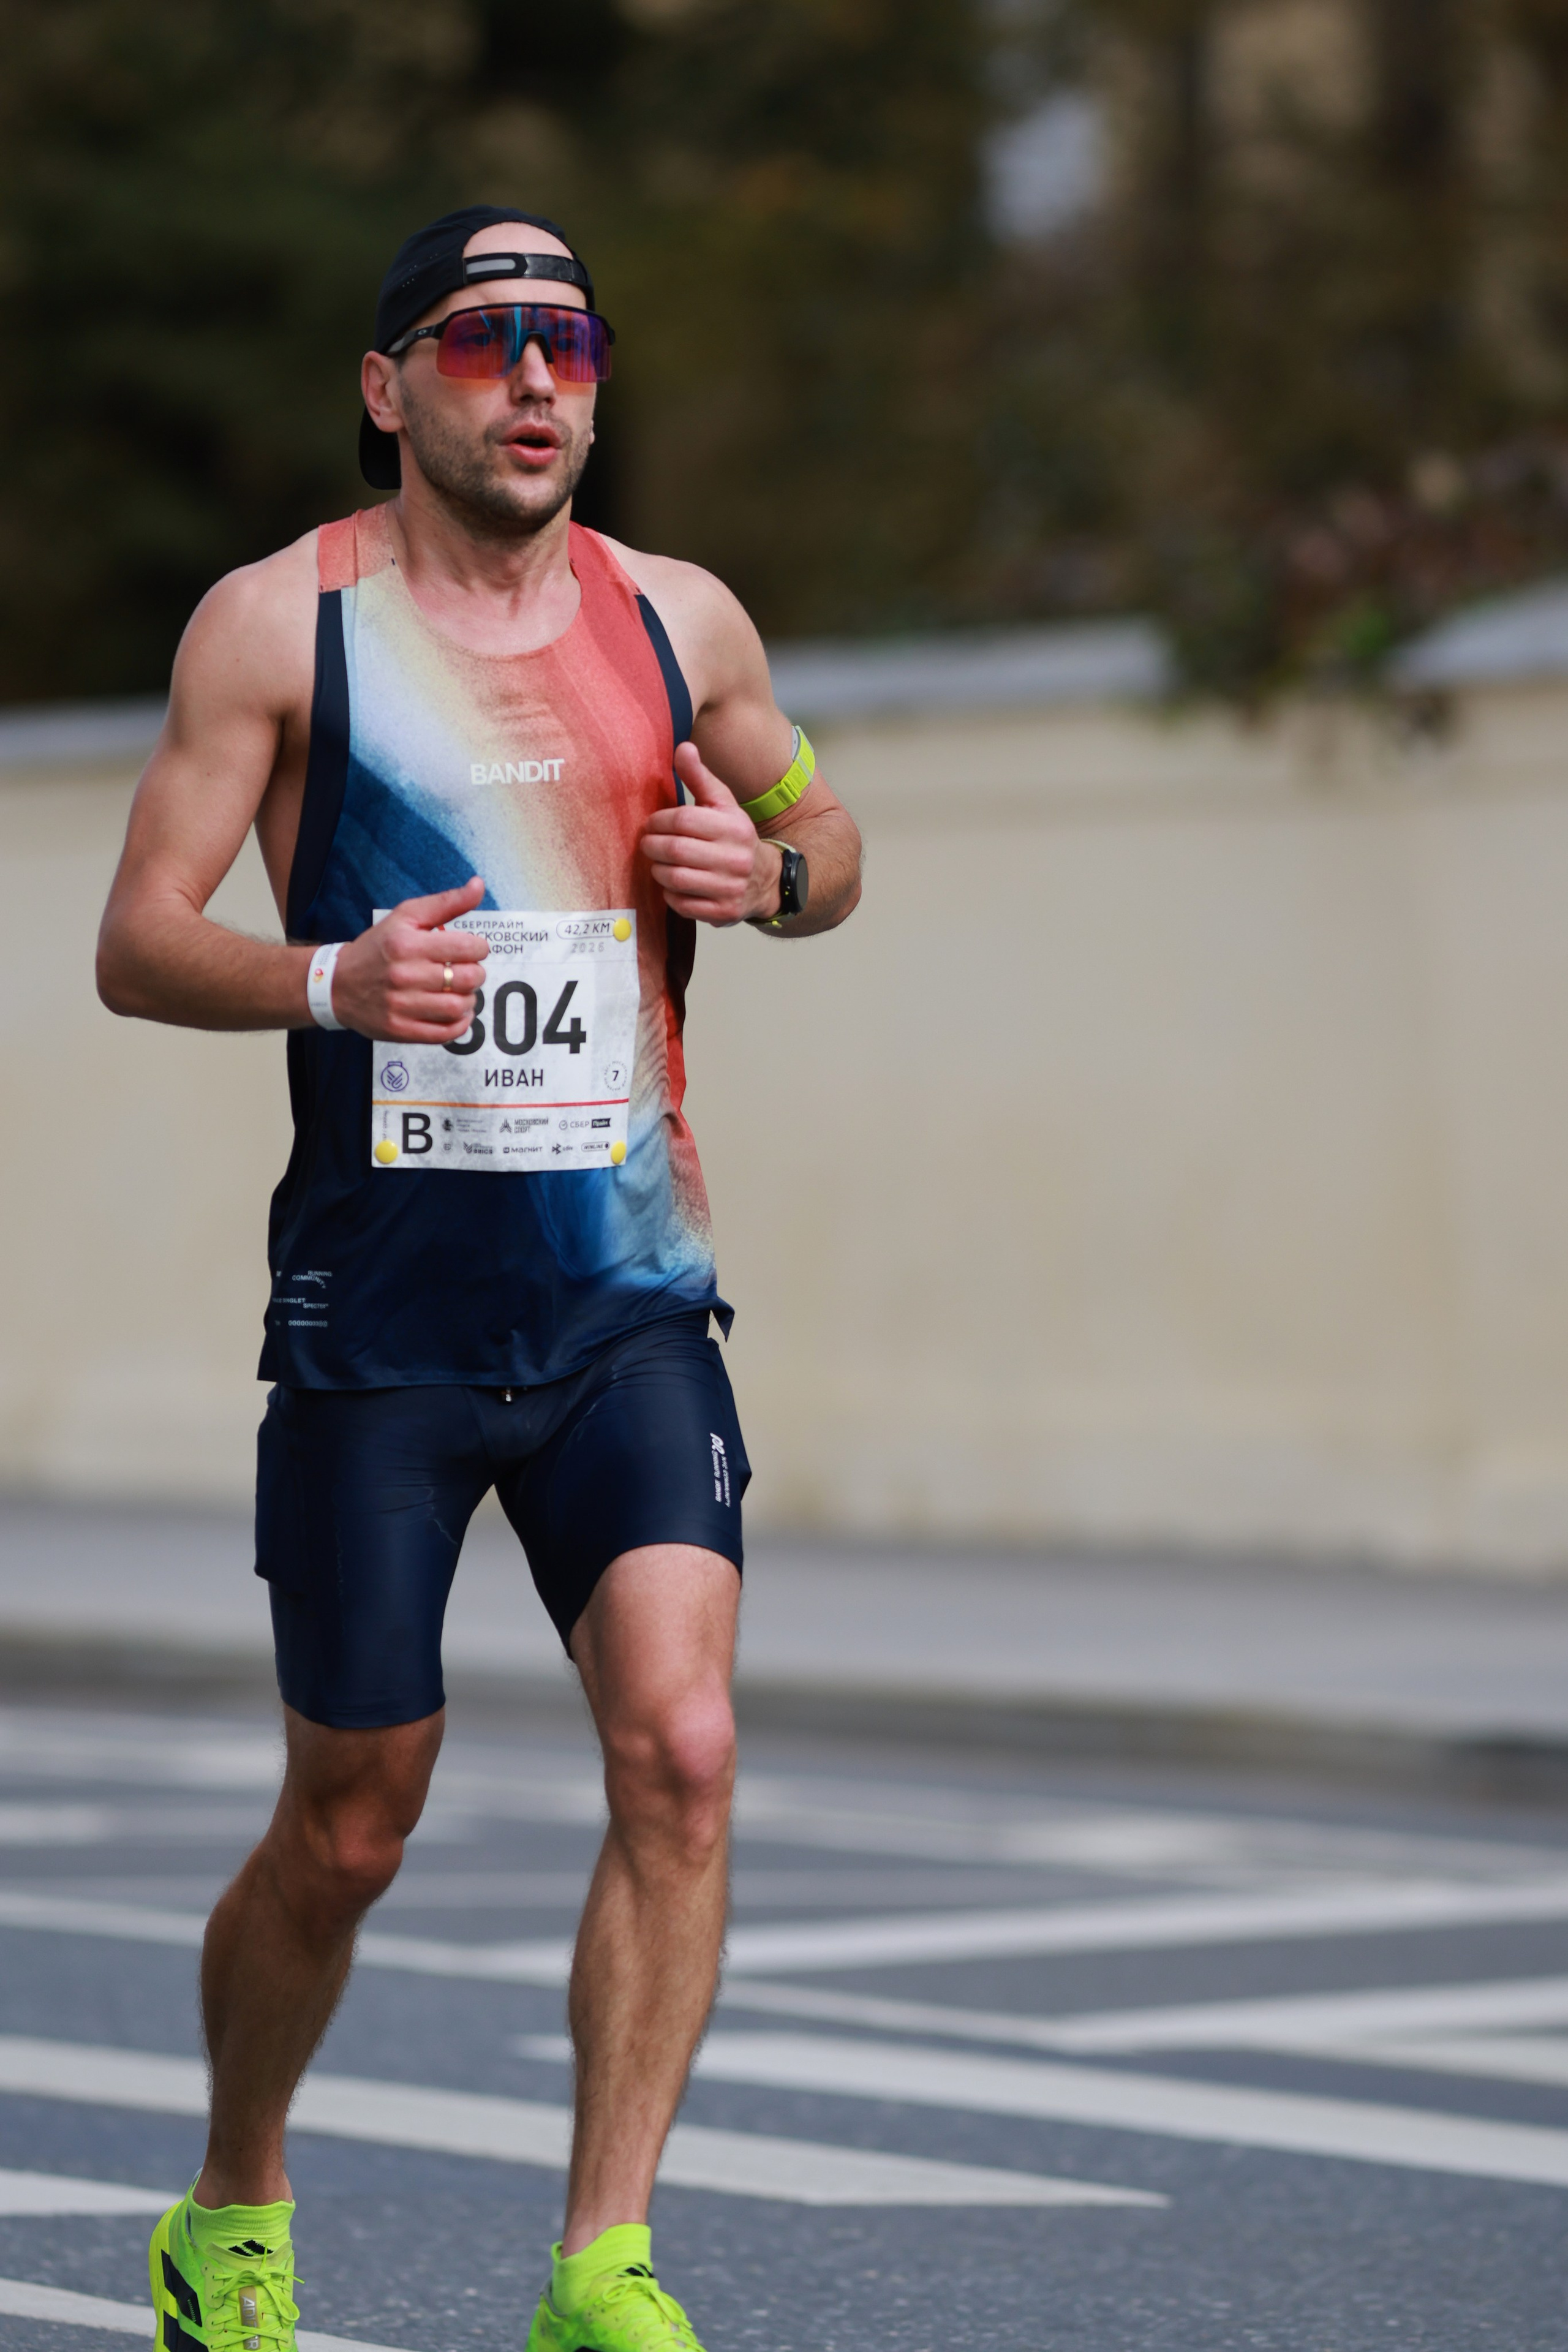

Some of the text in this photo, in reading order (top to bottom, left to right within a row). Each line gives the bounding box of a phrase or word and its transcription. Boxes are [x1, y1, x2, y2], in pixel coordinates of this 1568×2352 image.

[470, 758, 565, 785] BANDIT
[454, 920, 524, 929] СБЕРПРАЙМ
[565, 924, 589, 935] 42,2
[570, 942, 605, 953] 2026
[485, 1069, 543, 1087] ИВАН
[612, 1070, 619, 1081] 7
[402, 1112, 433, 1154] B
